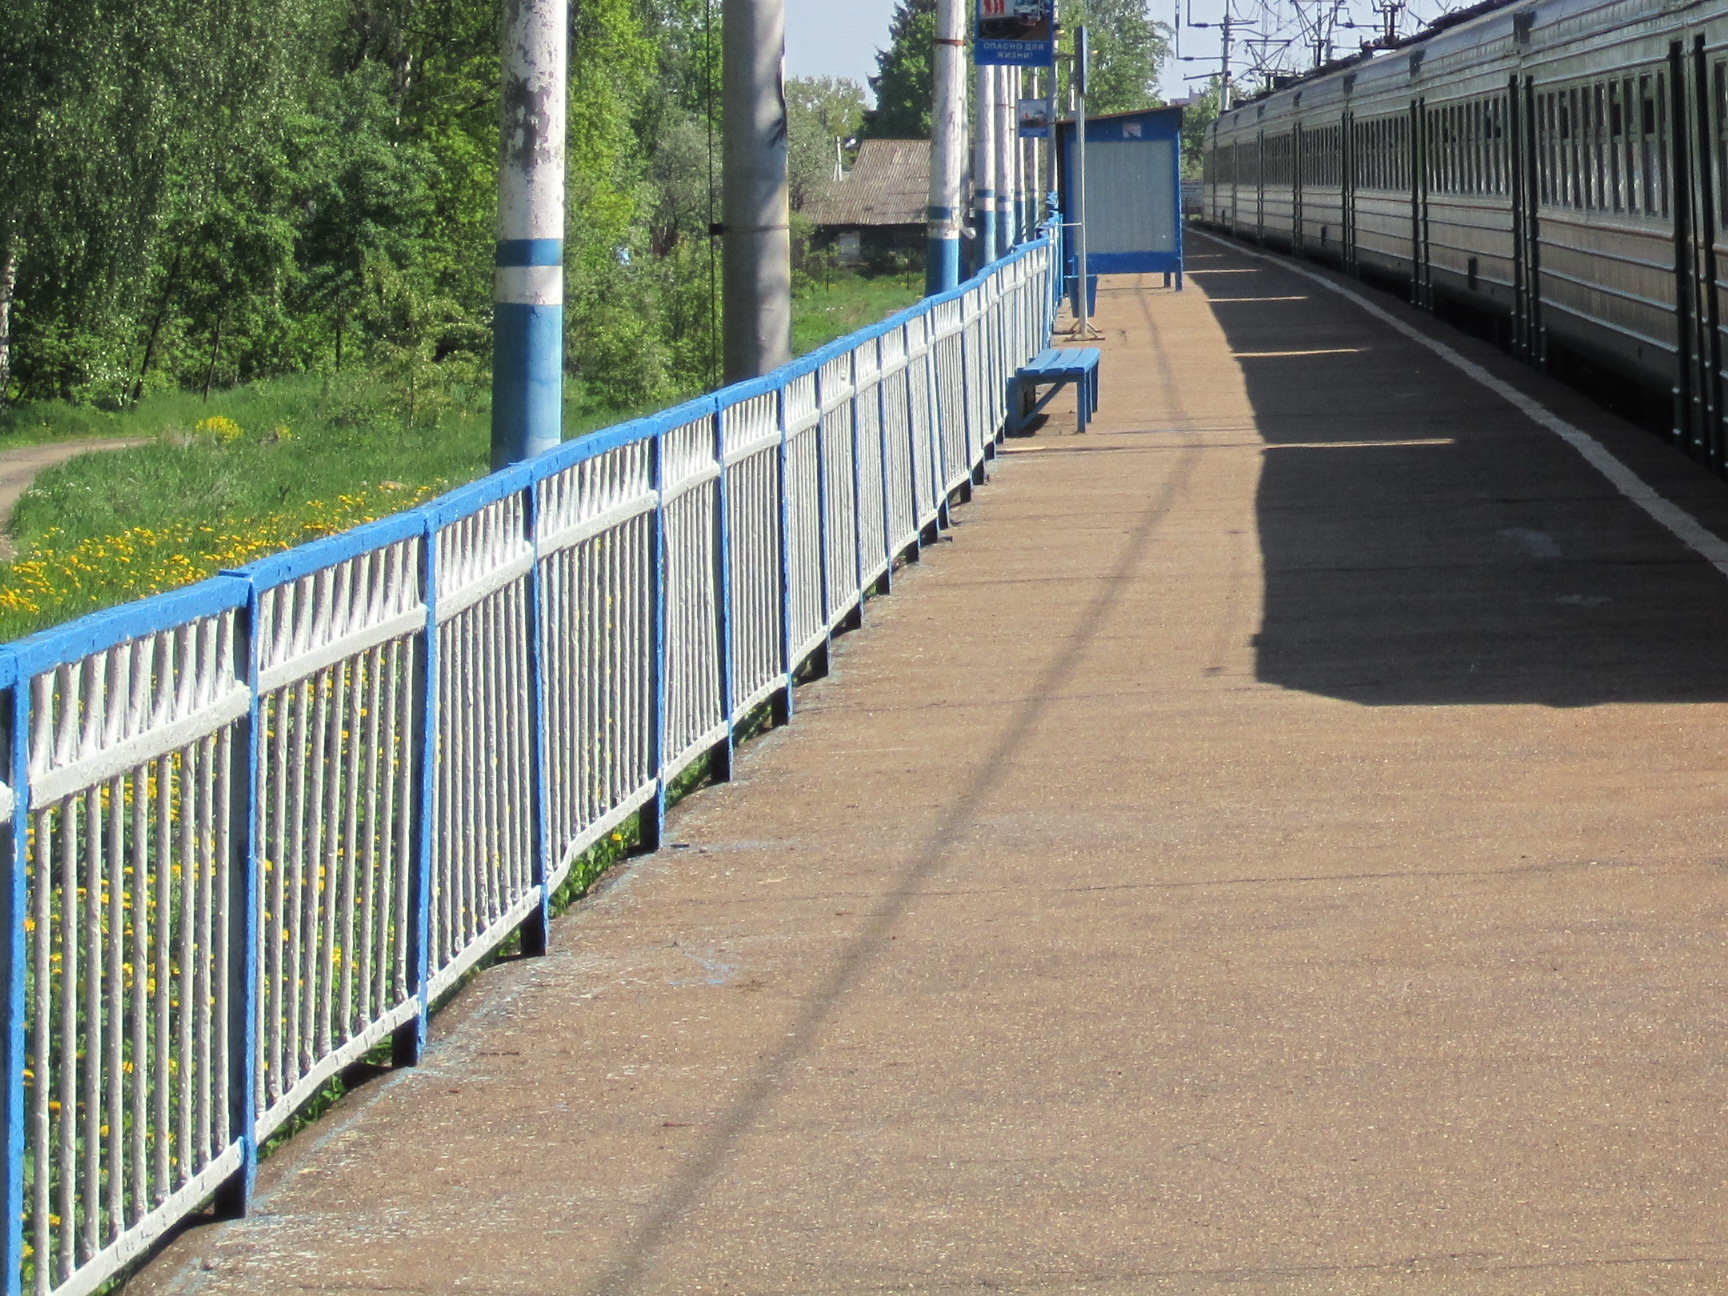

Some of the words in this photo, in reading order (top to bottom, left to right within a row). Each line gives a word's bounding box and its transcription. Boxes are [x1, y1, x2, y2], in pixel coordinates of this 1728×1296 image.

[983, 42, 1023, 50] ОПАСНО
[1024, 43, 1044, 51] ДЛЯ
[997, 51, 1033, 59] ЖИЗНИ!
